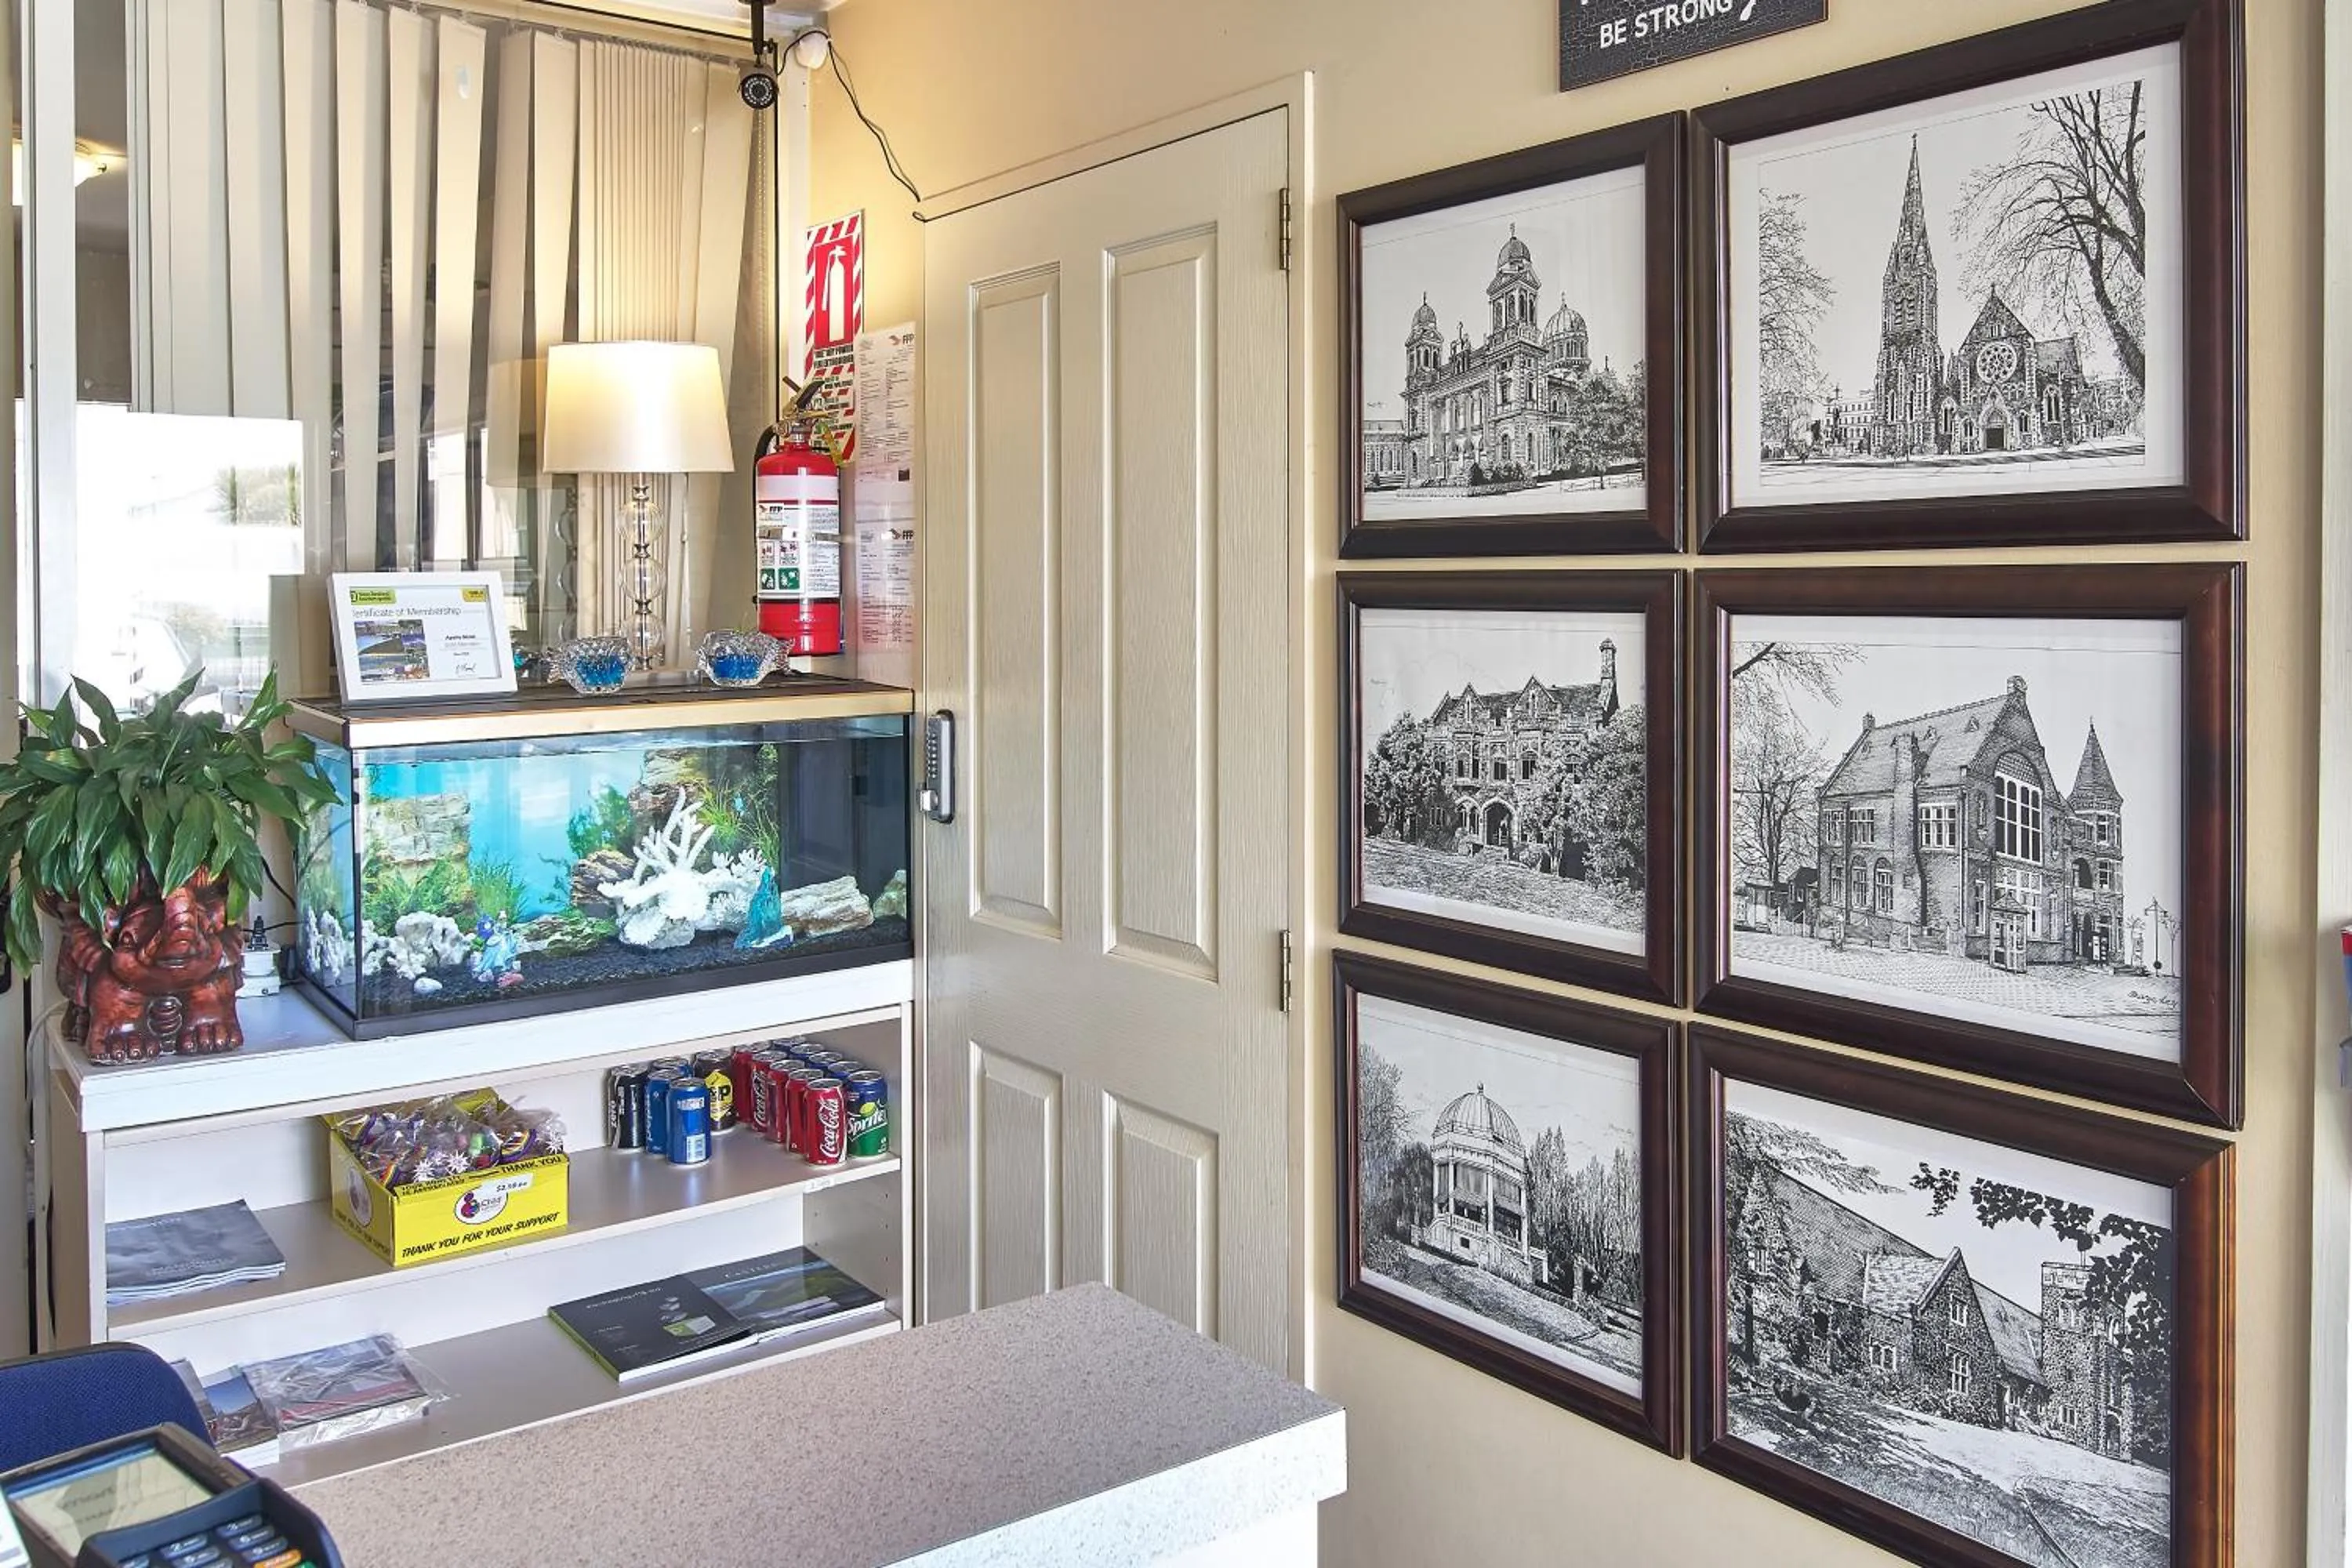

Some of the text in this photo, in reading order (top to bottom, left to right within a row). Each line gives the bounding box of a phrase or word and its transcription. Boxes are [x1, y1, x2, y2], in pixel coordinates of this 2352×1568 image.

[1600, 0, 1733, 49] BE STRONG
[902, 529, 914, 540] FFP
[818, 1096, 840, 1157] Coca-Cola
[848, 1109, 887, 1136] Sprite
[501, 1156, 562, 1174] THANK YOU
[402, 1211, 561, 1258] THANK YOU FOR YOUR SUPPORT
